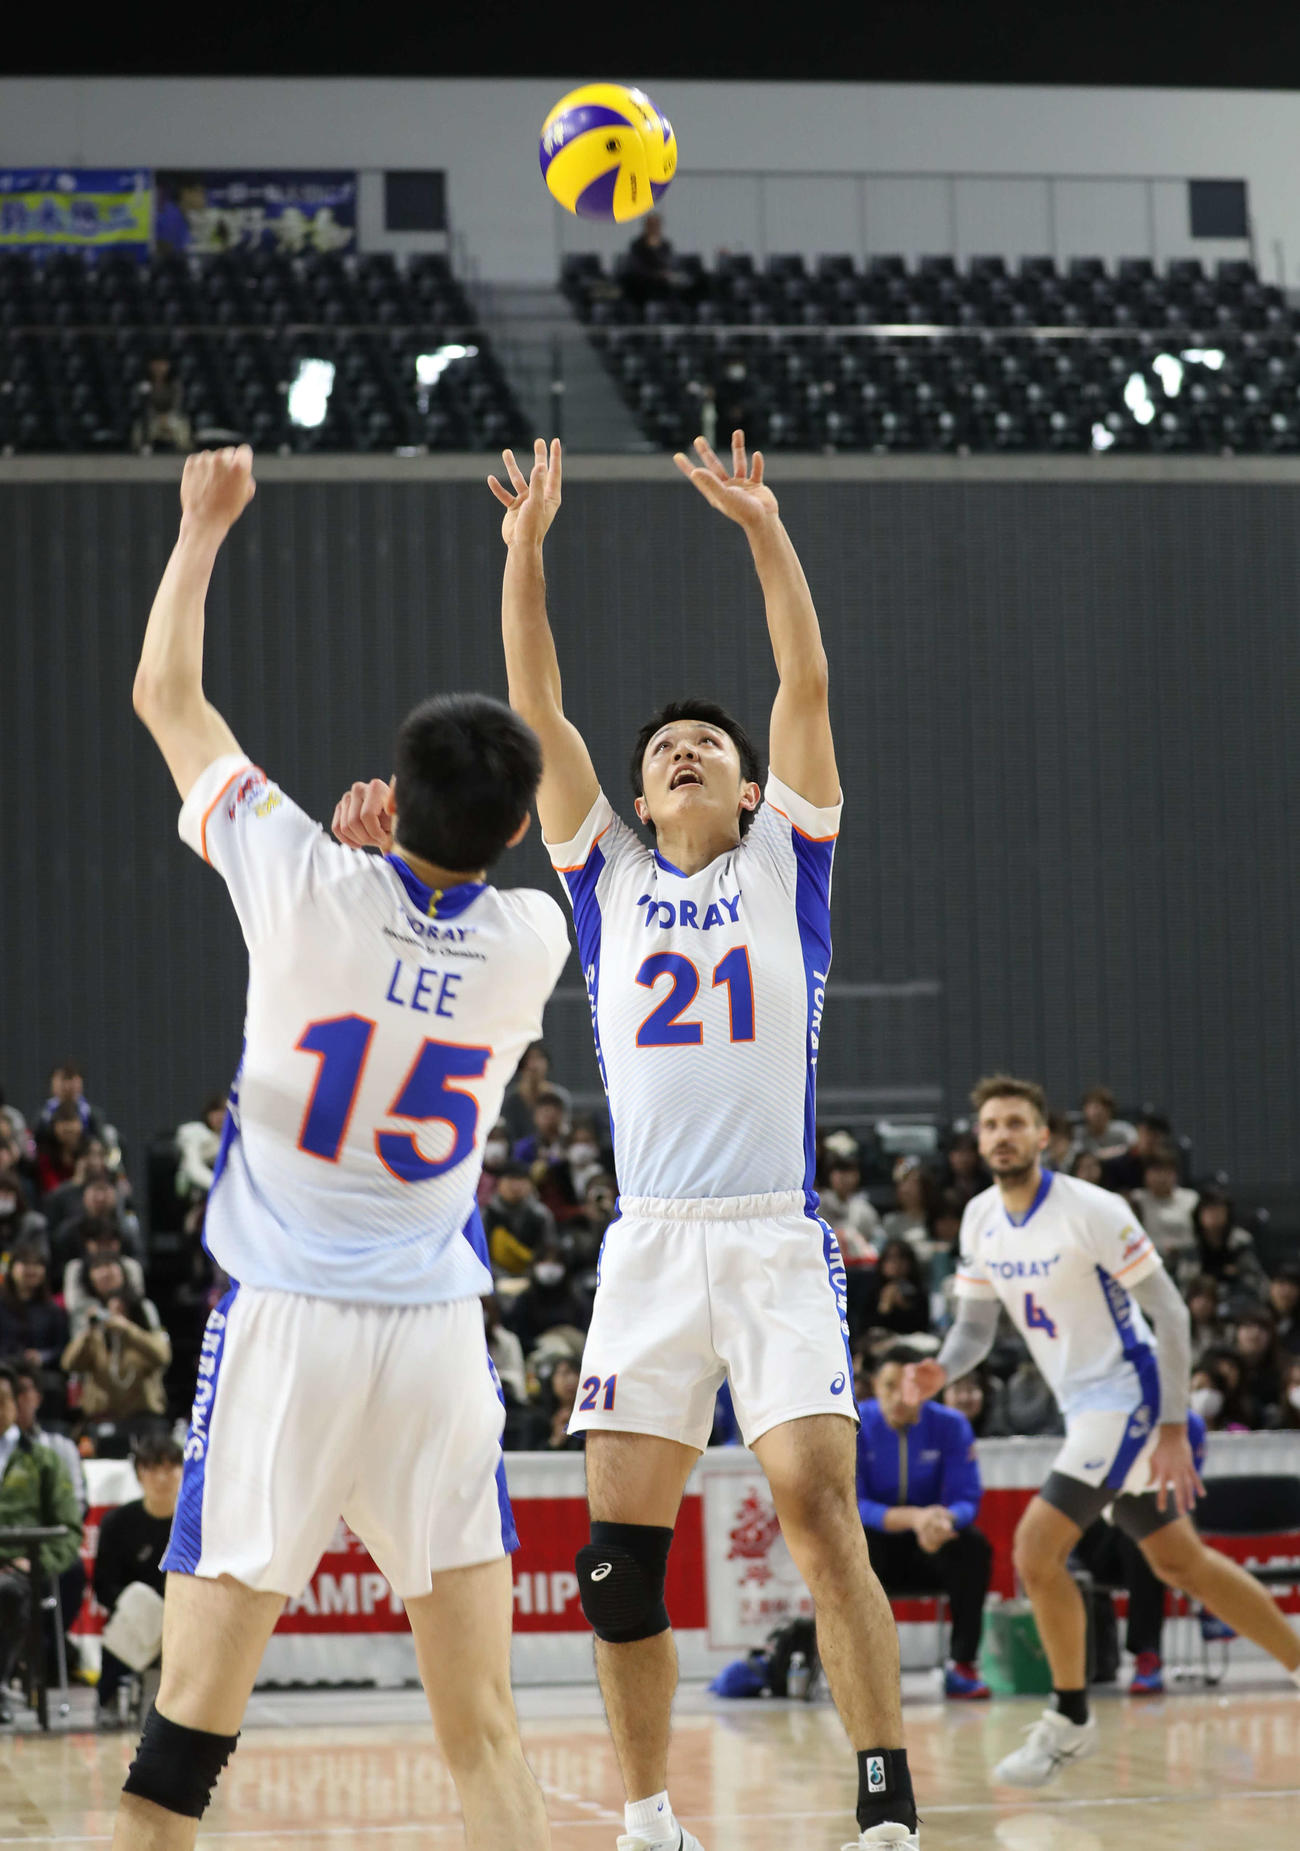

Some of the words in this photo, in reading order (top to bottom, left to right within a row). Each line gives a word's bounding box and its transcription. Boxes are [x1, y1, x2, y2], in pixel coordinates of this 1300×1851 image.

[405, 914, 468, 942] ORAY
[386, 959, 462, 1018] LEE
[635, 945, 756, 1048] 21
[293, 1012, 493, 1184] 15
[988, 1258, 1056, 1279] TORAY
[1023, 1290, 1058, 1338] 4
[579, 1373, 618, 1411] 21
